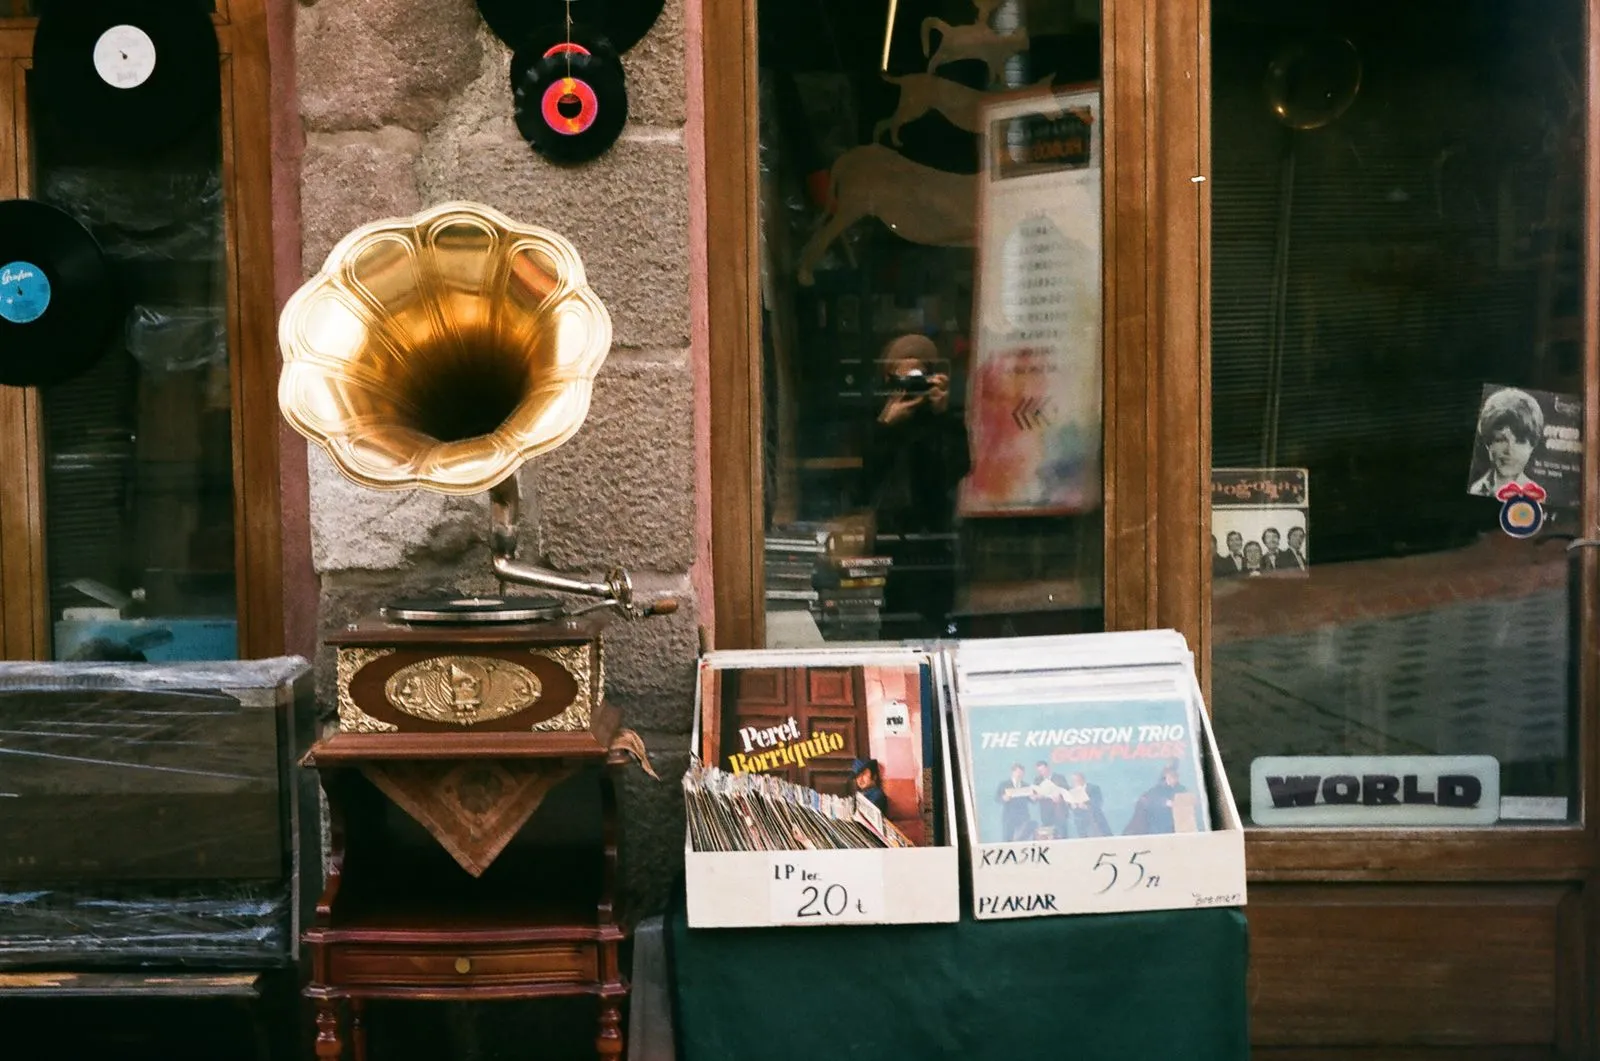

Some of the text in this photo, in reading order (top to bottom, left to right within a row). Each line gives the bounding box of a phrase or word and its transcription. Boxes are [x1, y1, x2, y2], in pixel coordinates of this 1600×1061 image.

[739, 716, 801, 753] Peret
[981, 724, 1184, 748] THE KINGSTON TRIO
[728, 731, 844, 776] Borriquito
[1265, 774, 1482, 808] WORLD
[797, 884, 848, 917] 20
